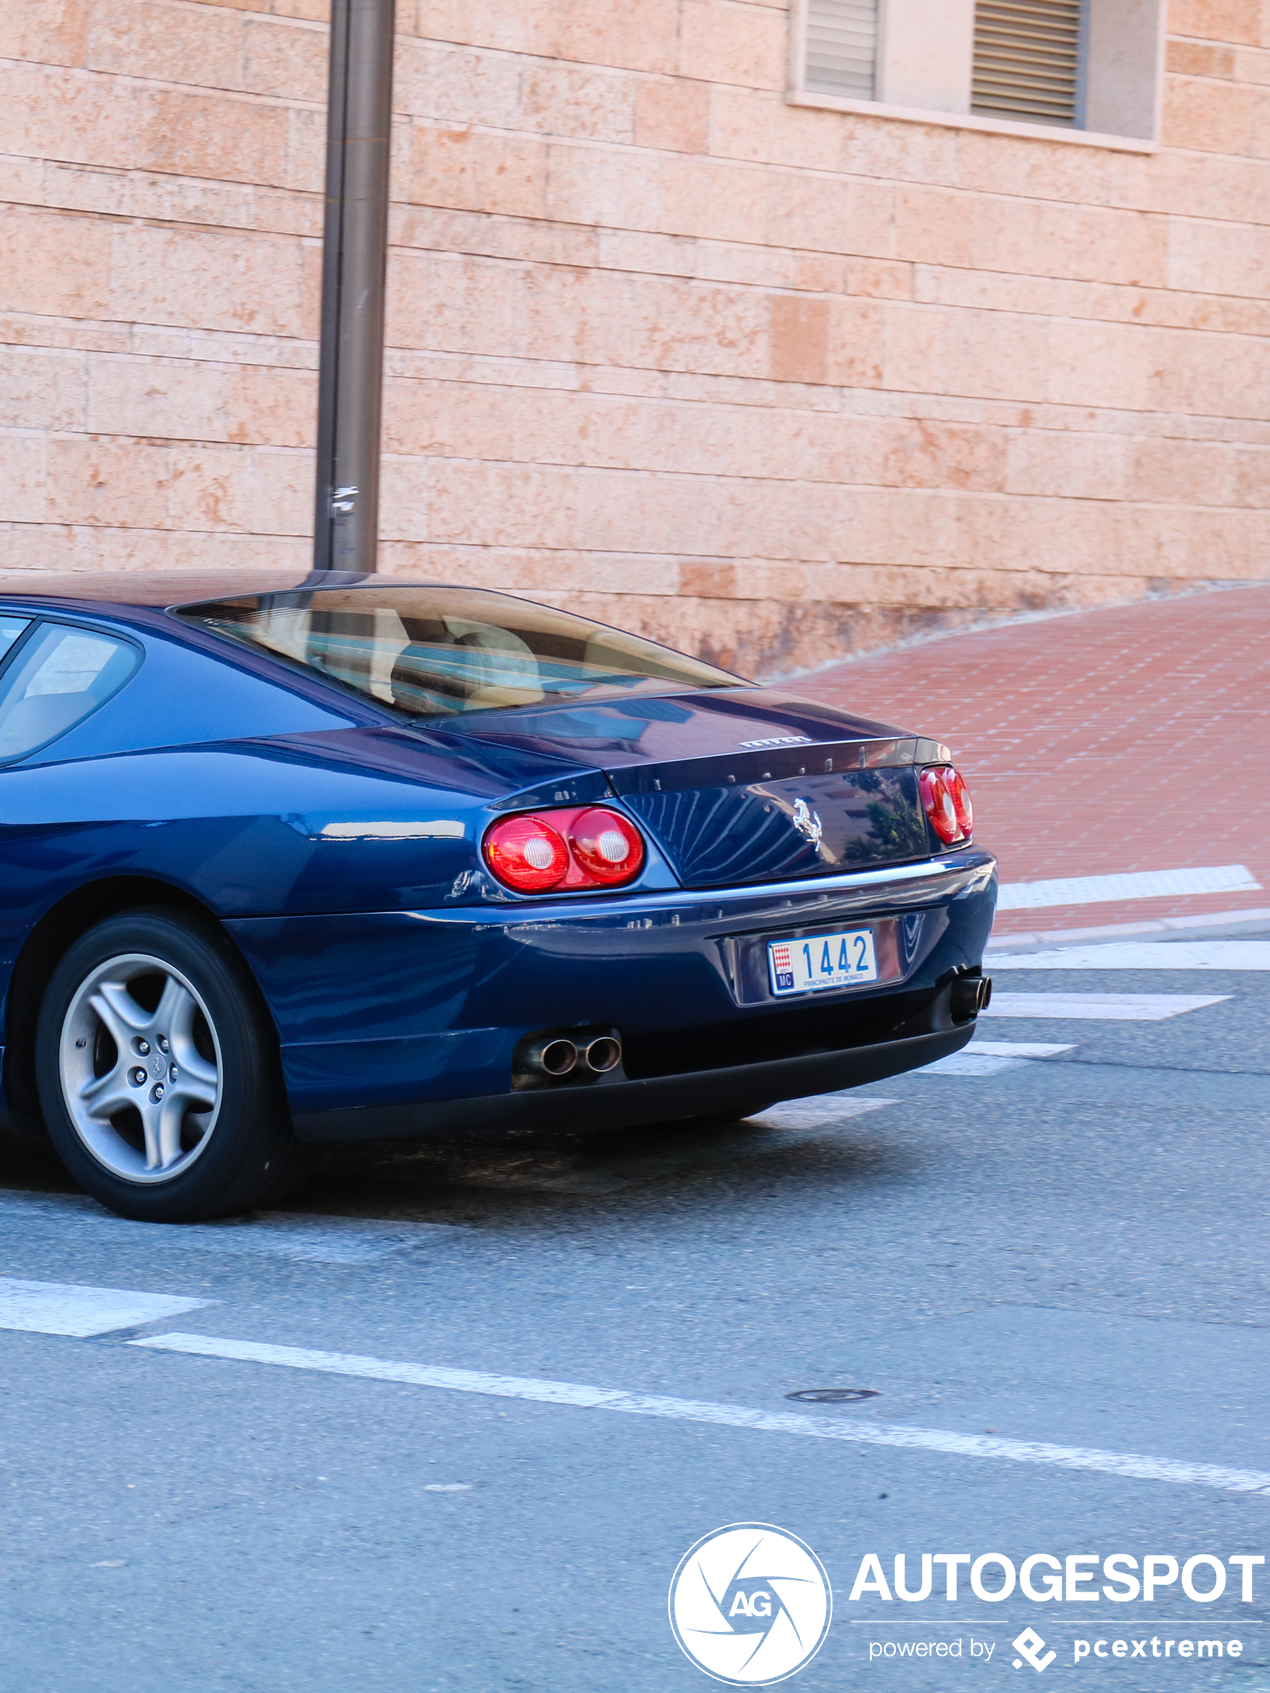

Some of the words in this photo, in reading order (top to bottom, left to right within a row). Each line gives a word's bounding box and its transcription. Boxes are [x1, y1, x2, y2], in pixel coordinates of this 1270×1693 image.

[803, 936, 869, 978] 1442
[779, 974, 791, 986] MC
[843, 973, 864, 982] MONACO
